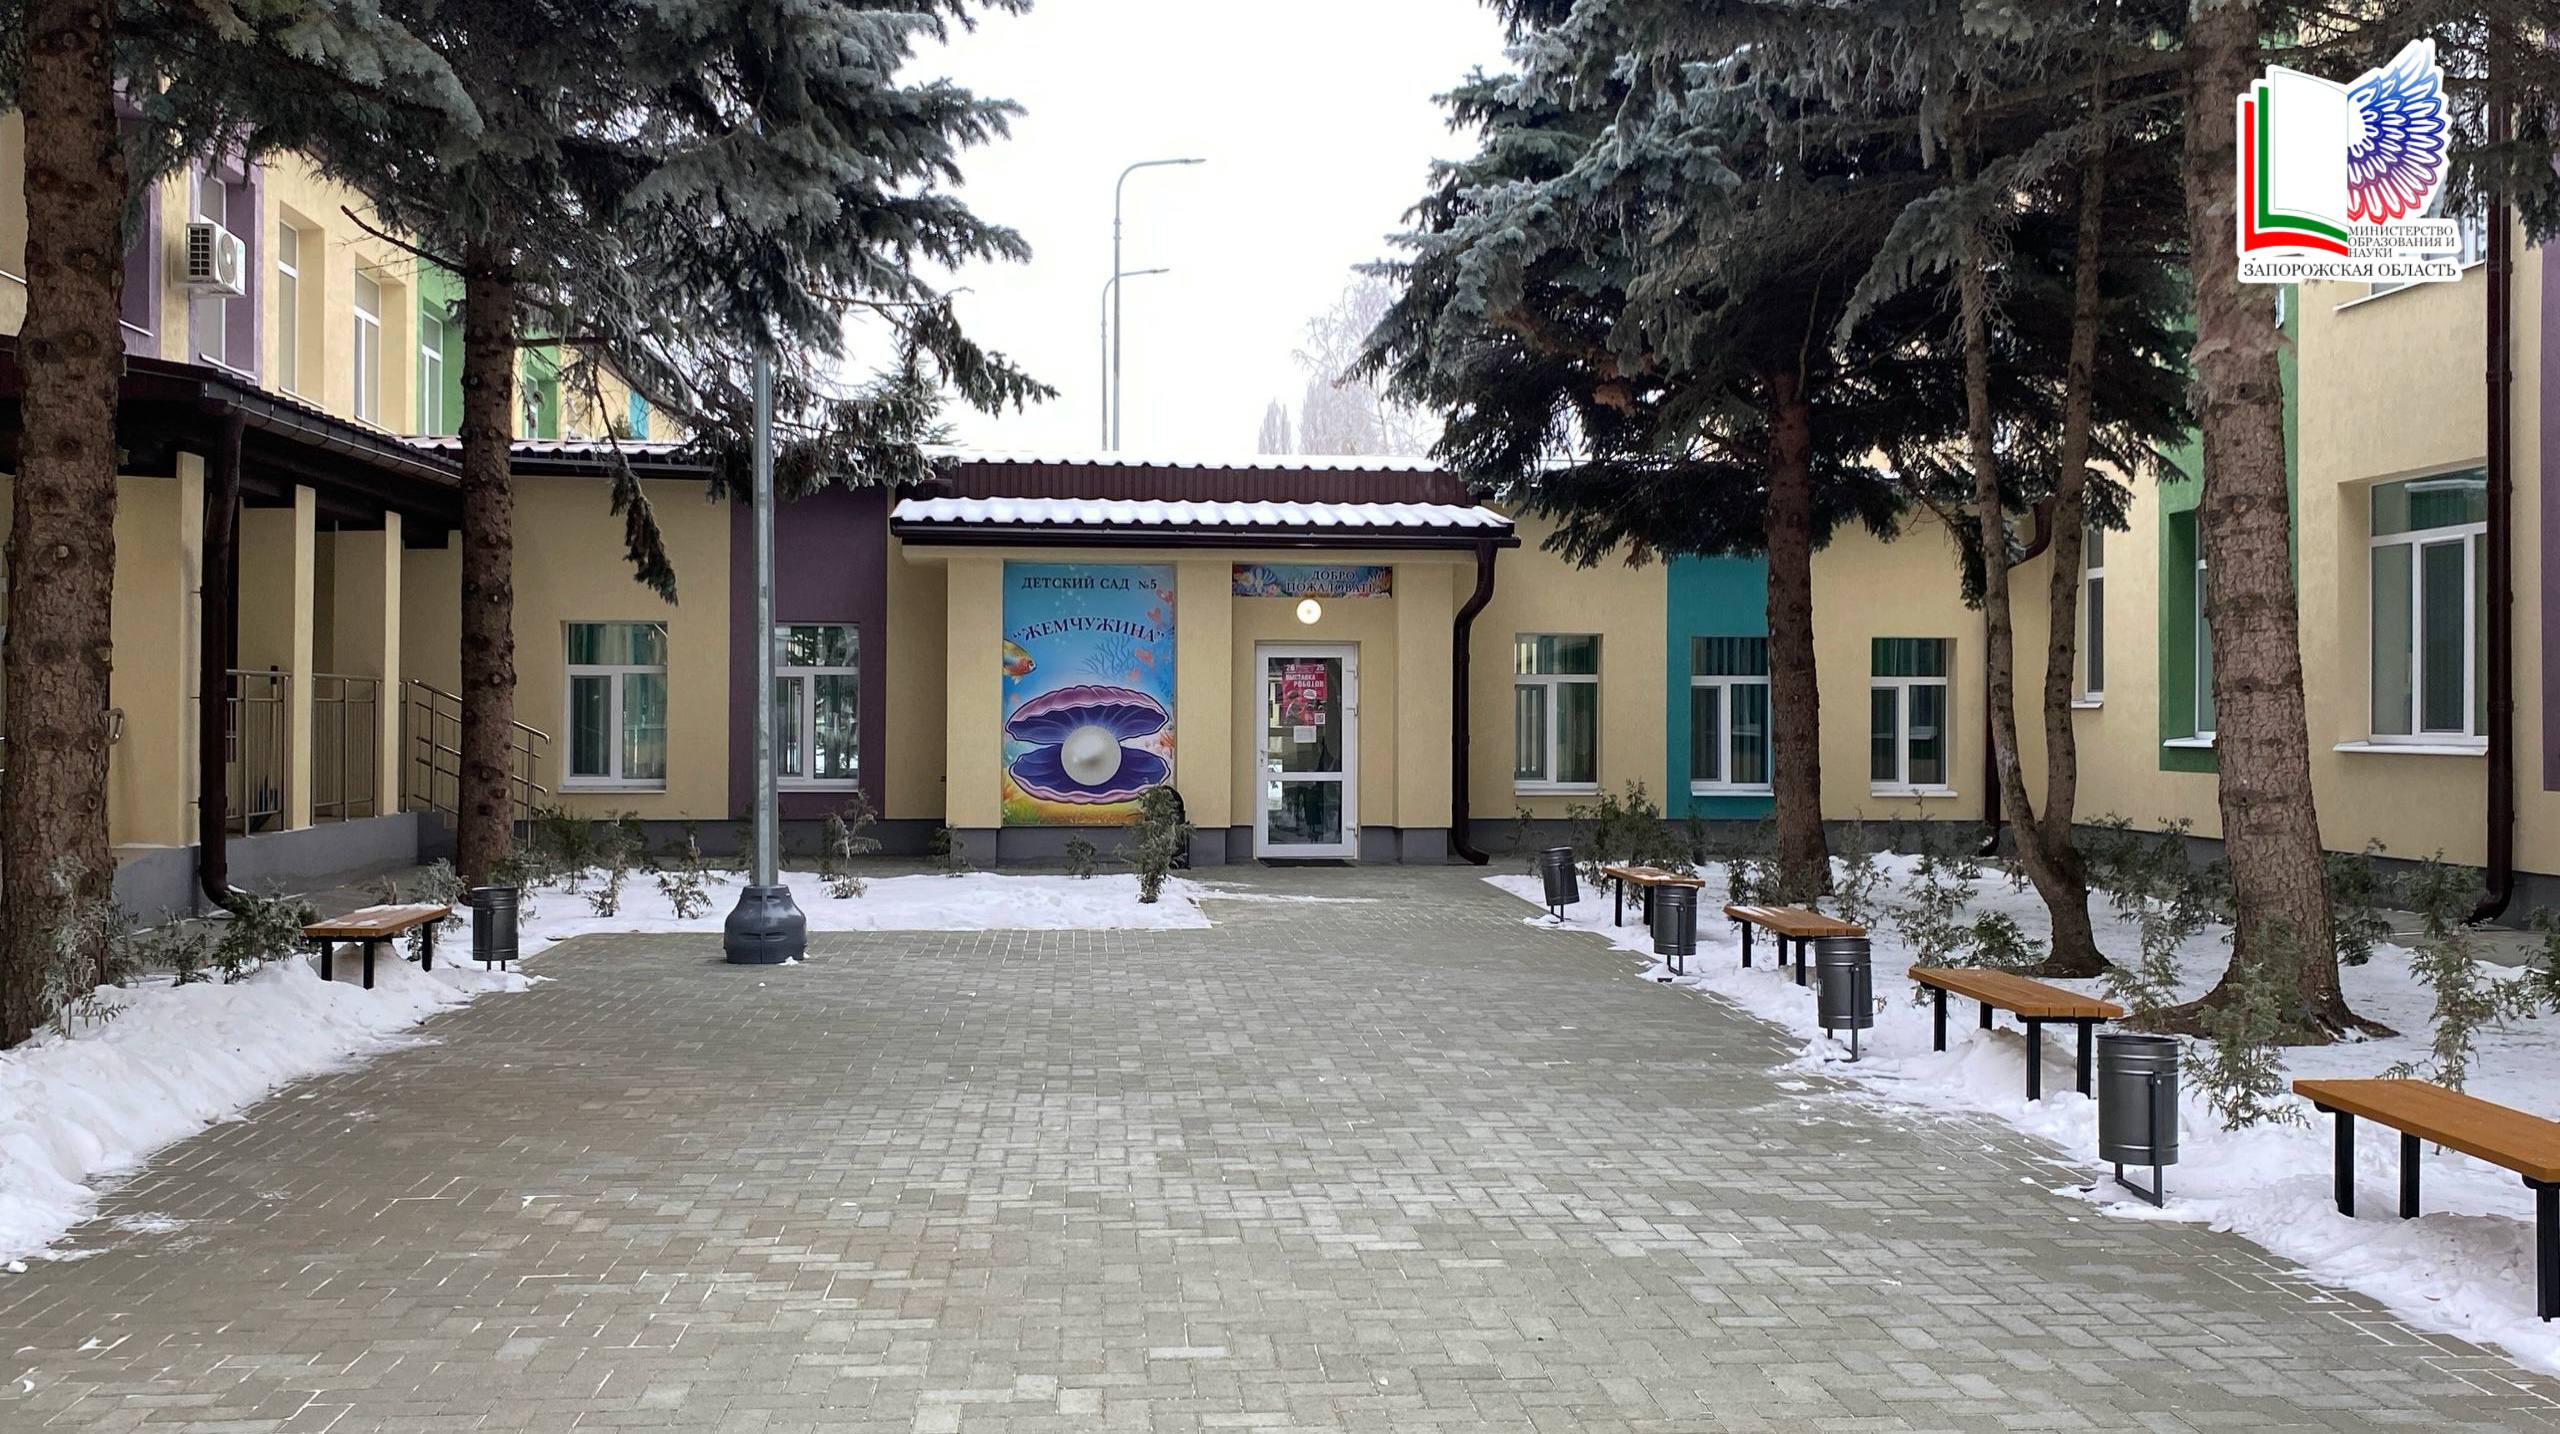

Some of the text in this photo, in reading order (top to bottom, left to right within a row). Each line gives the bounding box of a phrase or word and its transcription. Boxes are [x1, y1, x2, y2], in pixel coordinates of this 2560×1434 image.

[1312, 570, 1355, 581] ДОБРО
[1022, 576, 1095, 590] ДЕТСКИЙ
[1100, 578, 1129, 591] САД
